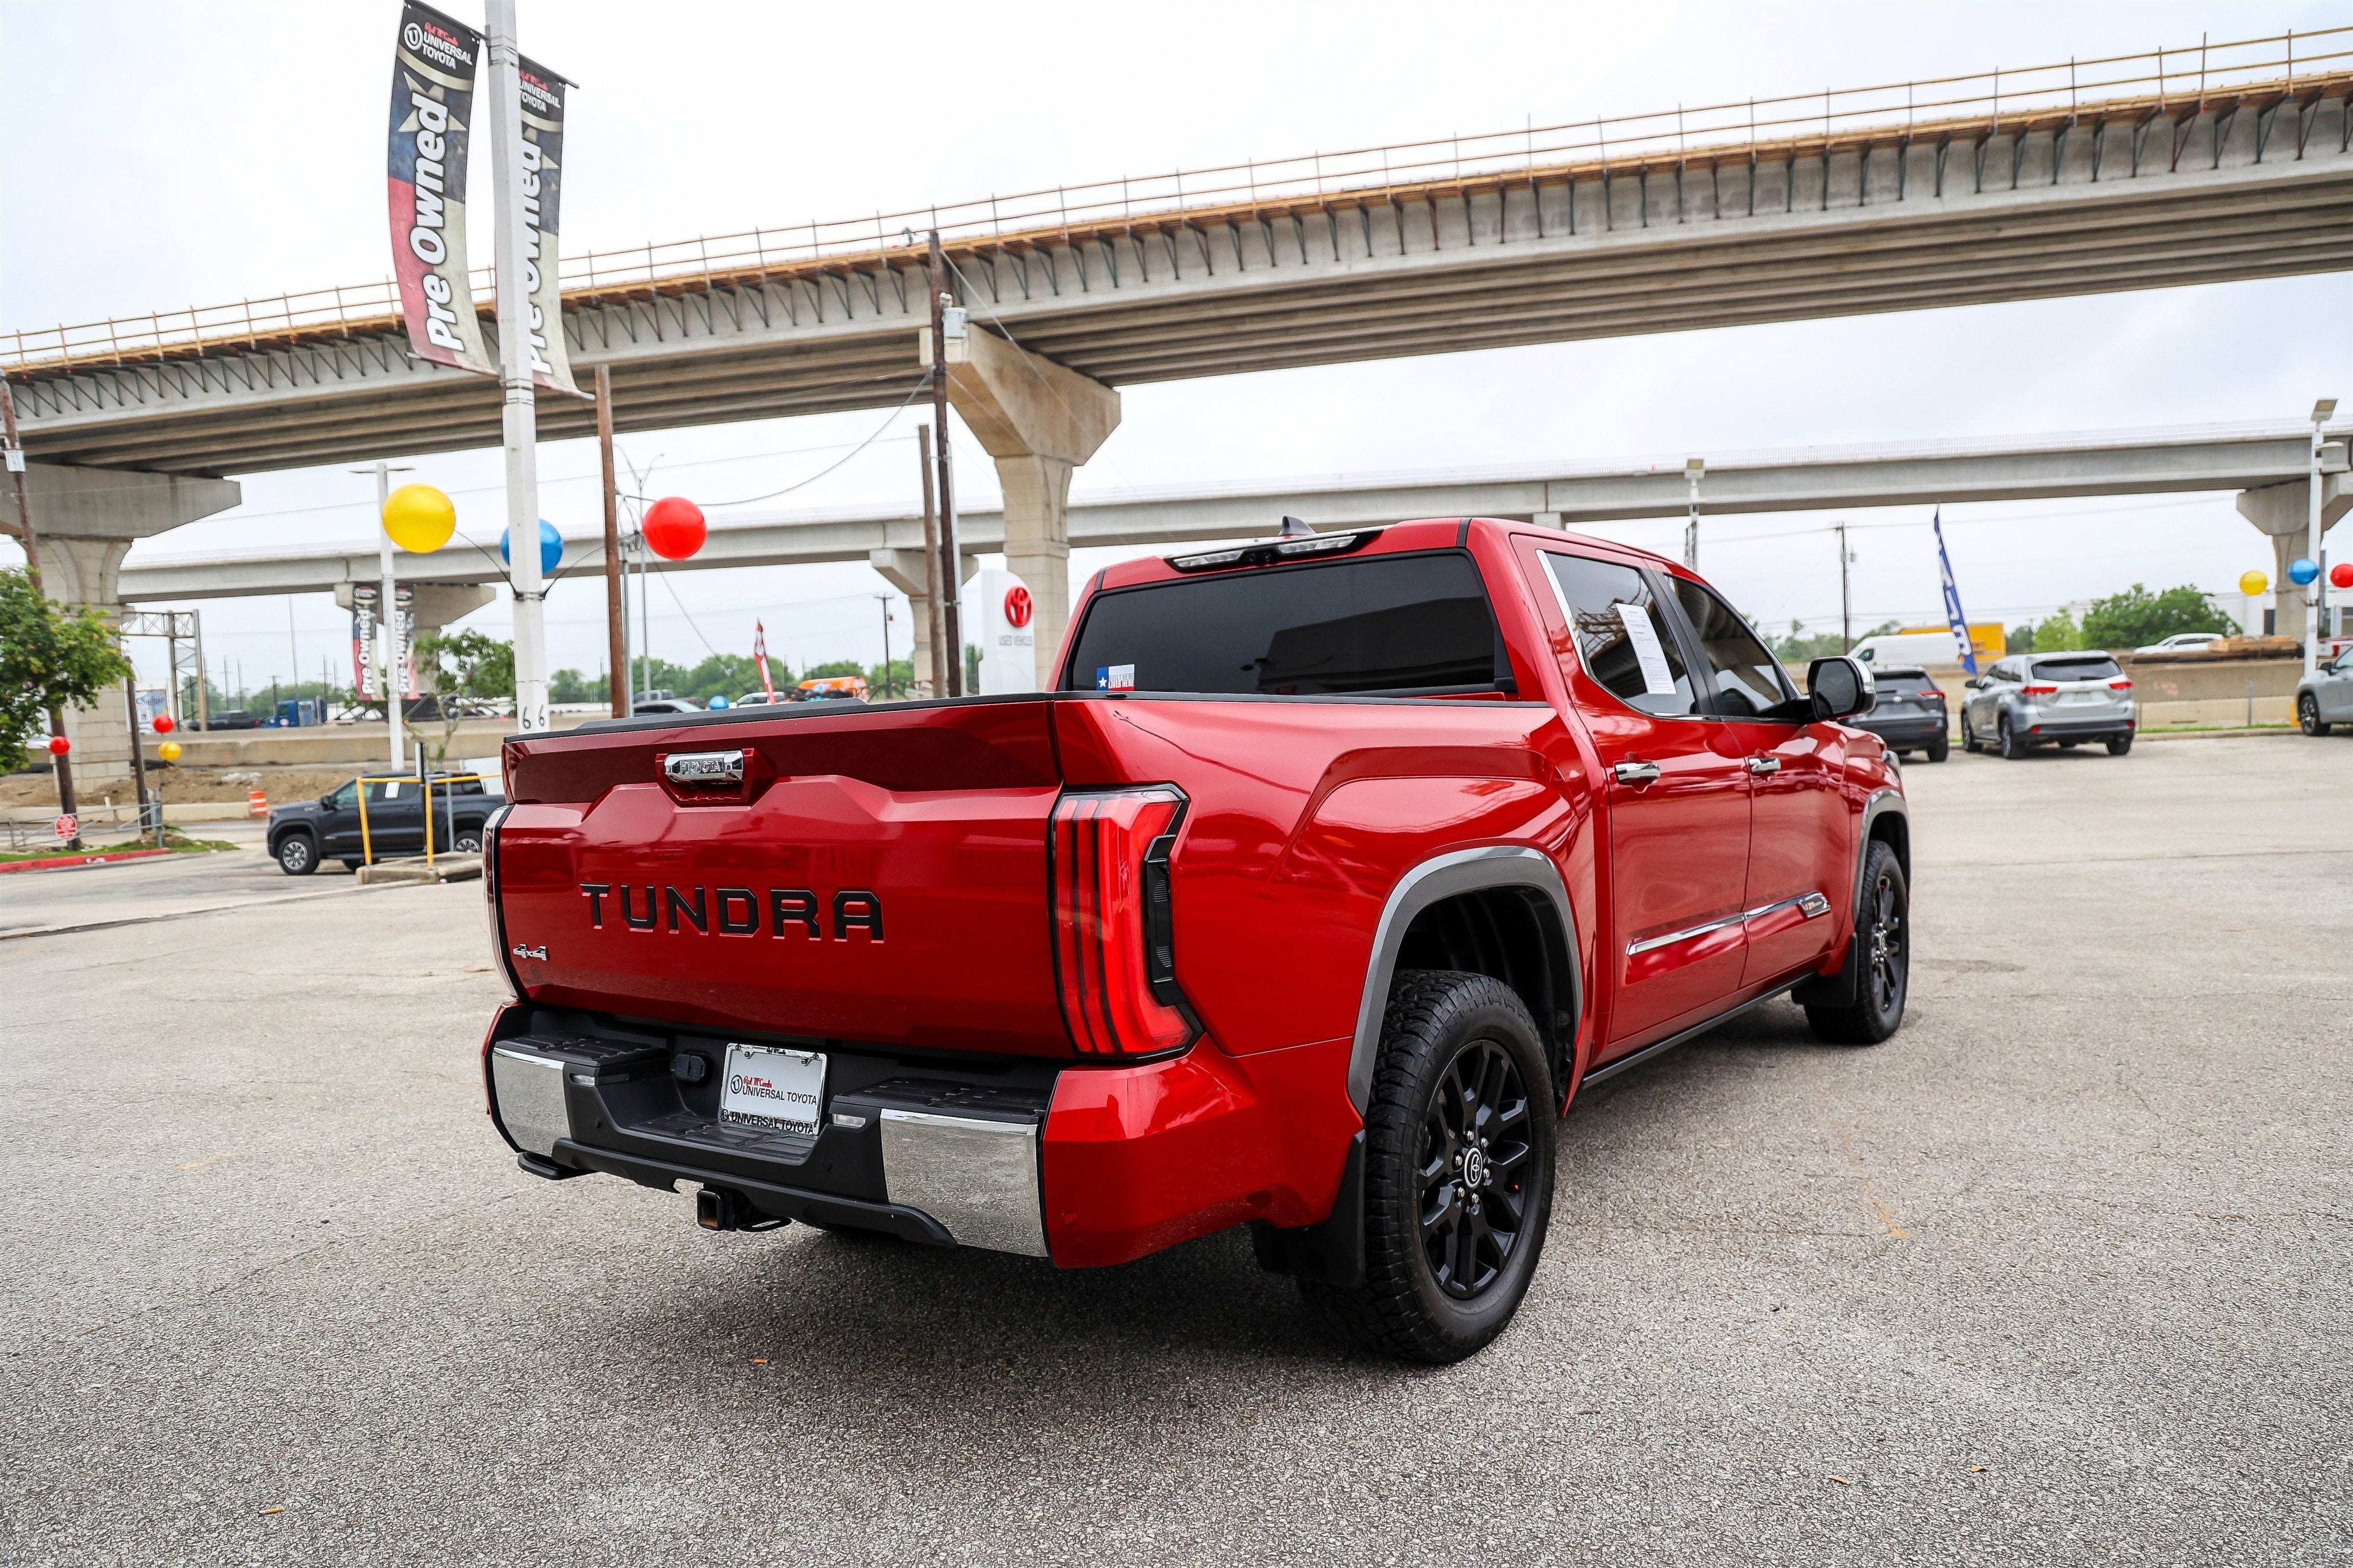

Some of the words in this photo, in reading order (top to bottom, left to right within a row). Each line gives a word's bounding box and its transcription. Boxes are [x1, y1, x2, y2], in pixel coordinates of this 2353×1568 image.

[422, 43, 457, 70] TOYOTA
[423, 30, 473, 66] UNIVERSAL
[519, 77, 562, 109] UNIVERSAL
[521, 91, 547, 113] OYOTA
[410, 92, 449, 265] Owned
[422, 274, 465, 352] Pre
[357, 609, 371, 665] Owned
[394, 610, 407, 664] Owned
[361, 667, 375, 694] Pre
[398, 667, 410, 693] Pre
[1108, 680, 1121, 689] LIVES
[1122, 679, 1134, 688] HERE
[522, 706, 531, 729] 6
[538, 704, 545, 727] 6
[684, 760, 721, 773] TOYOTA
[577, 883, 885, 944] TUNDRA
[744, 1076, 753, 1087] Red
[742, 1086, 785, 1100] UNIVERSAL
[787, 1092, 817, 1106] TOYOTA
[731, 1111, 780, 1129] UNIVERSAL
[781, 1119, 813, 1134] TOYOTA
